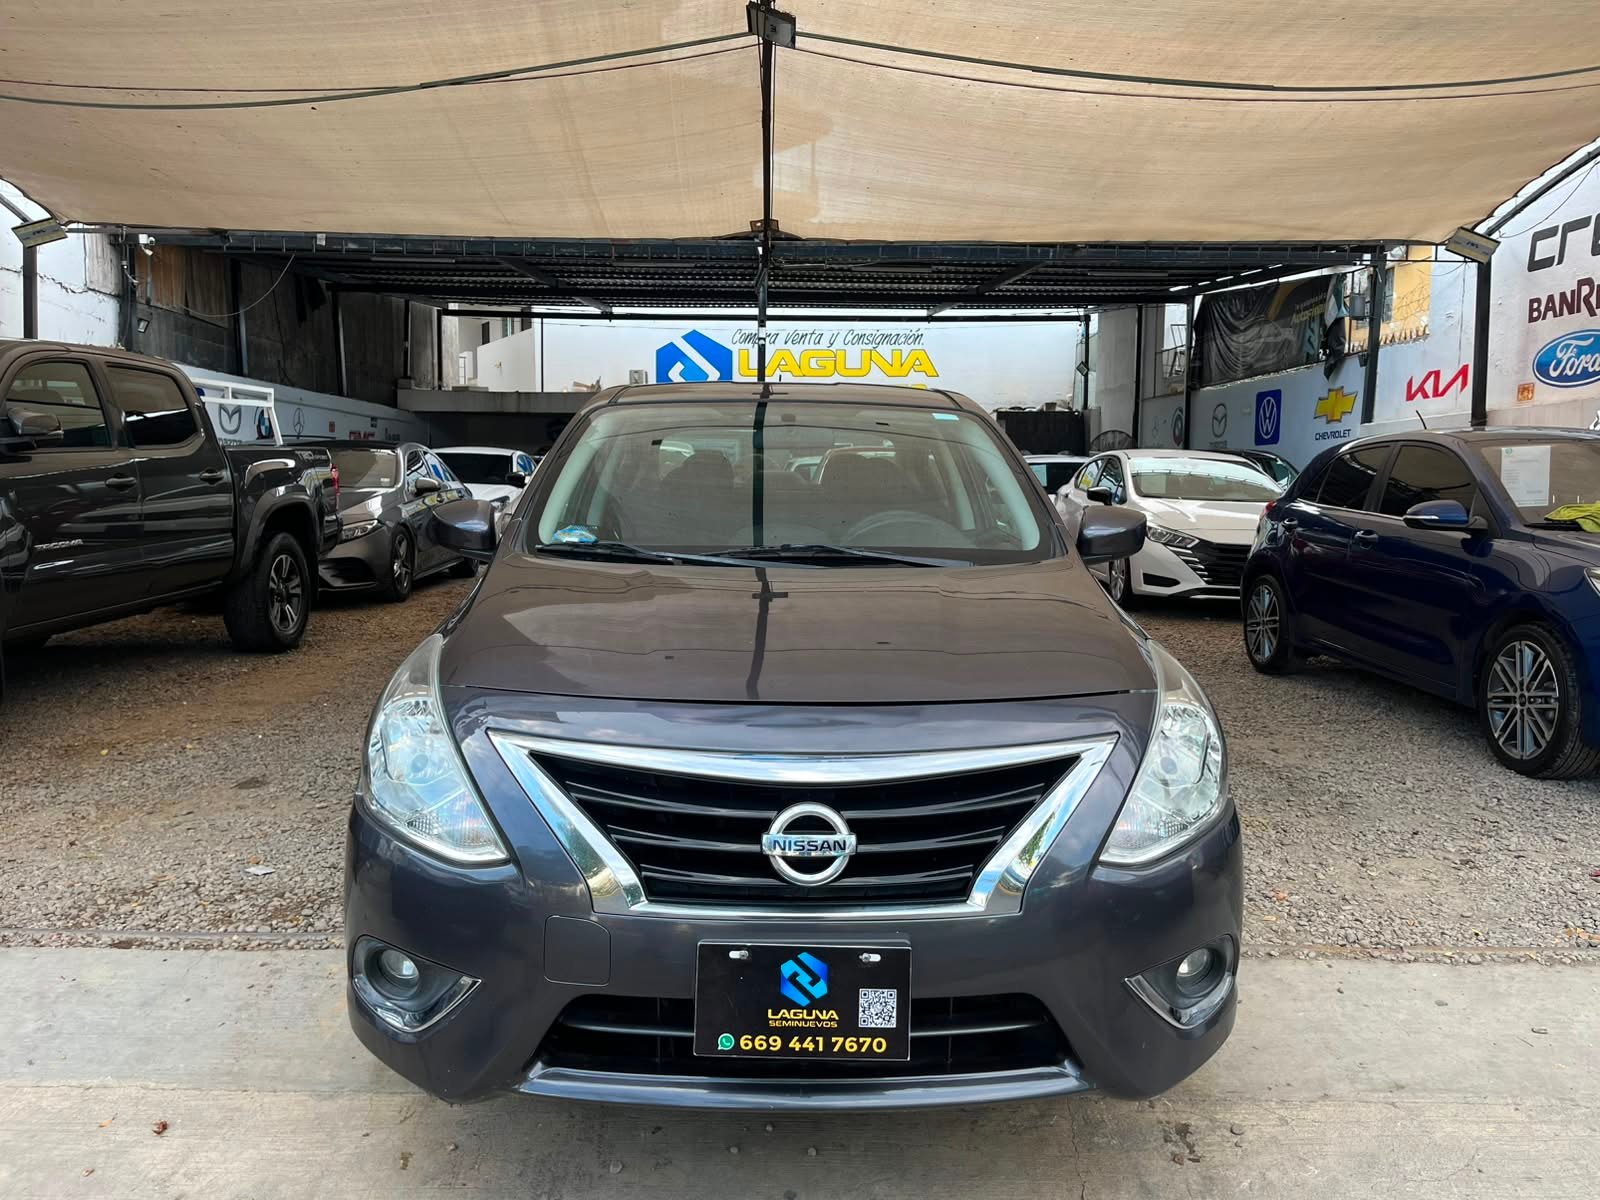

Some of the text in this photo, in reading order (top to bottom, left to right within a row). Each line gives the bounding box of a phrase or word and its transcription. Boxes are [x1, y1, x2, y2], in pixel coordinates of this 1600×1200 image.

[1528, 277, 1600, 323] BANR
[784, 328, 824, 345] Venta
[827, 331, 840, 348] y
[737, 349, 939, 377] LAGUNA
[1405, 363, 1469, 401] KIA
[1314, 429, 1352, 441] CHEVROLET
[773, 839, 847, 852] NISSAN
[767, 1008, 839, 1020] LAGUNA
[768, 1020, 838, 1028] SEMINUEVOS
[739, 1034, 888, 1053] 669 441 7670
